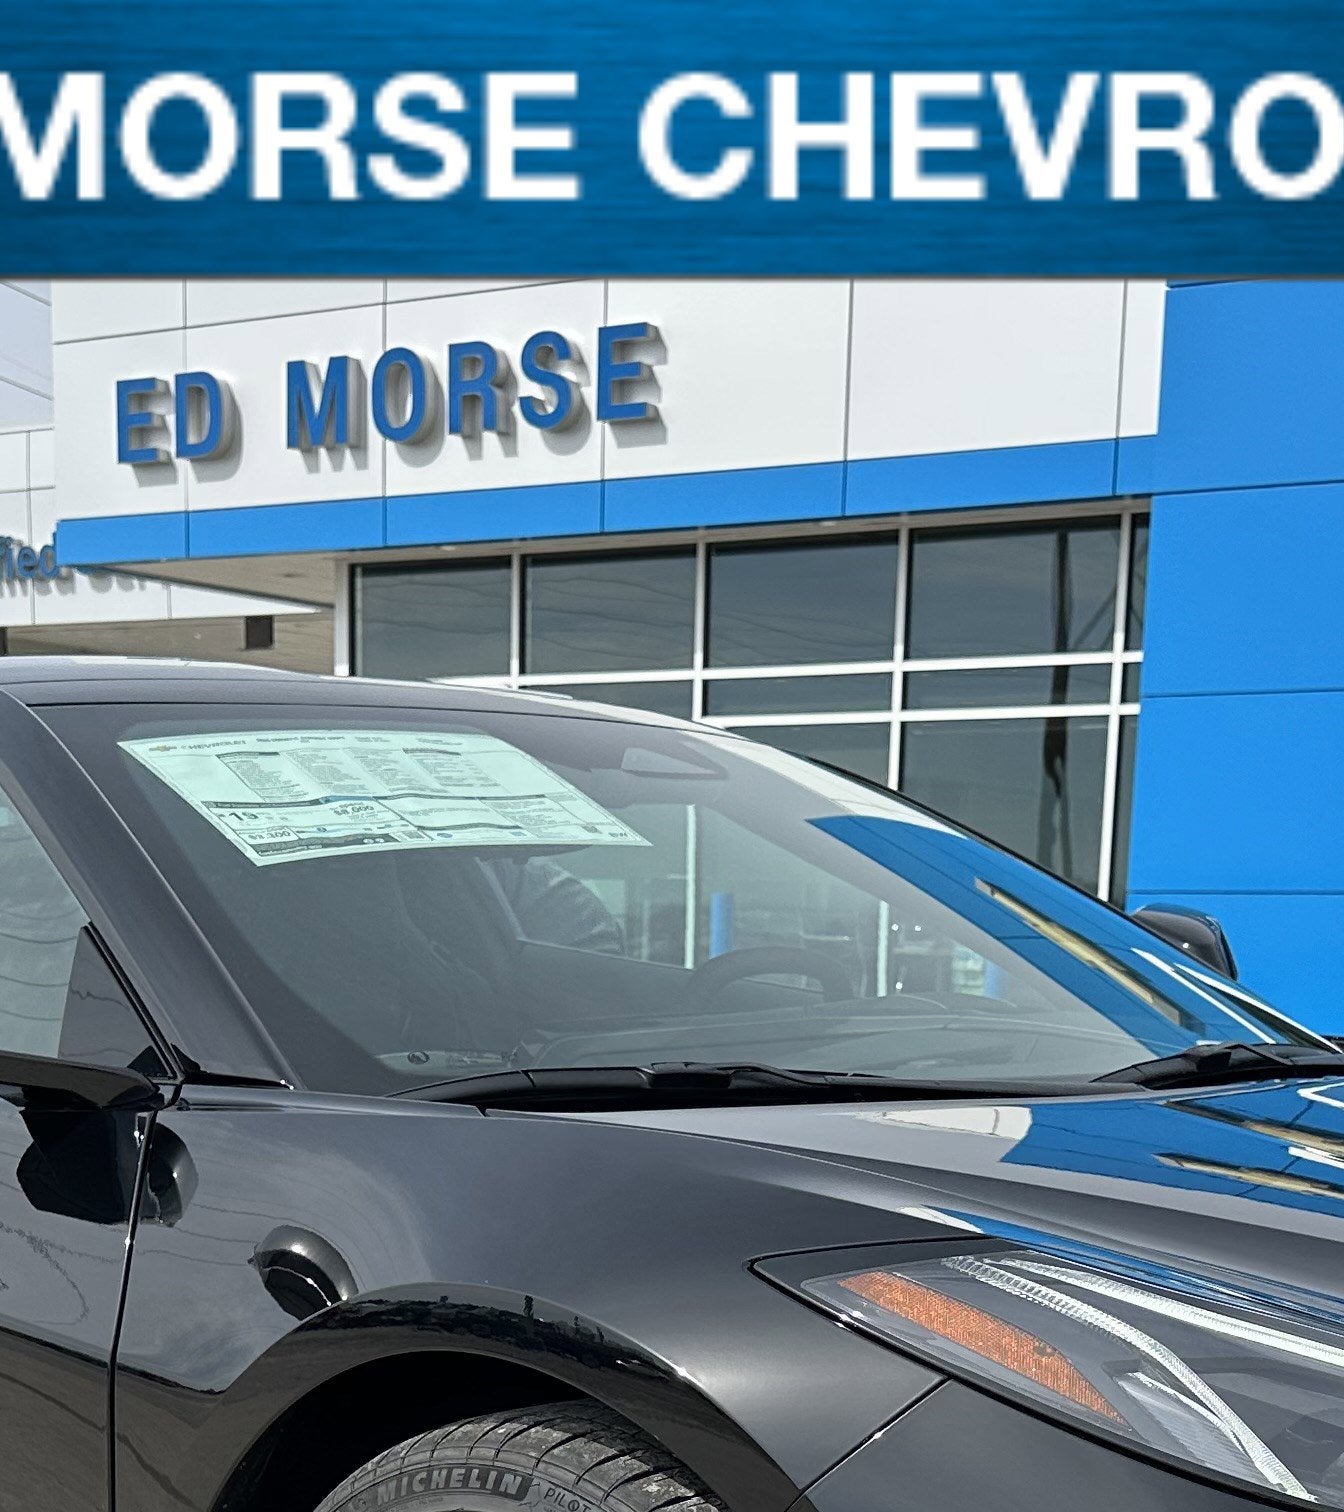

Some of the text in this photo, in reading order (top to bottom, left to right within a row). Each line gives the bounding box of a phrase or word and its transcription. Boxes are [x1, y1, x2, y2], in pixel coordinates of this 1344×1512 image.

[115, 321, 656, 465] ED MORSE
[377, 1467, 523, 1506] MICHELIN
